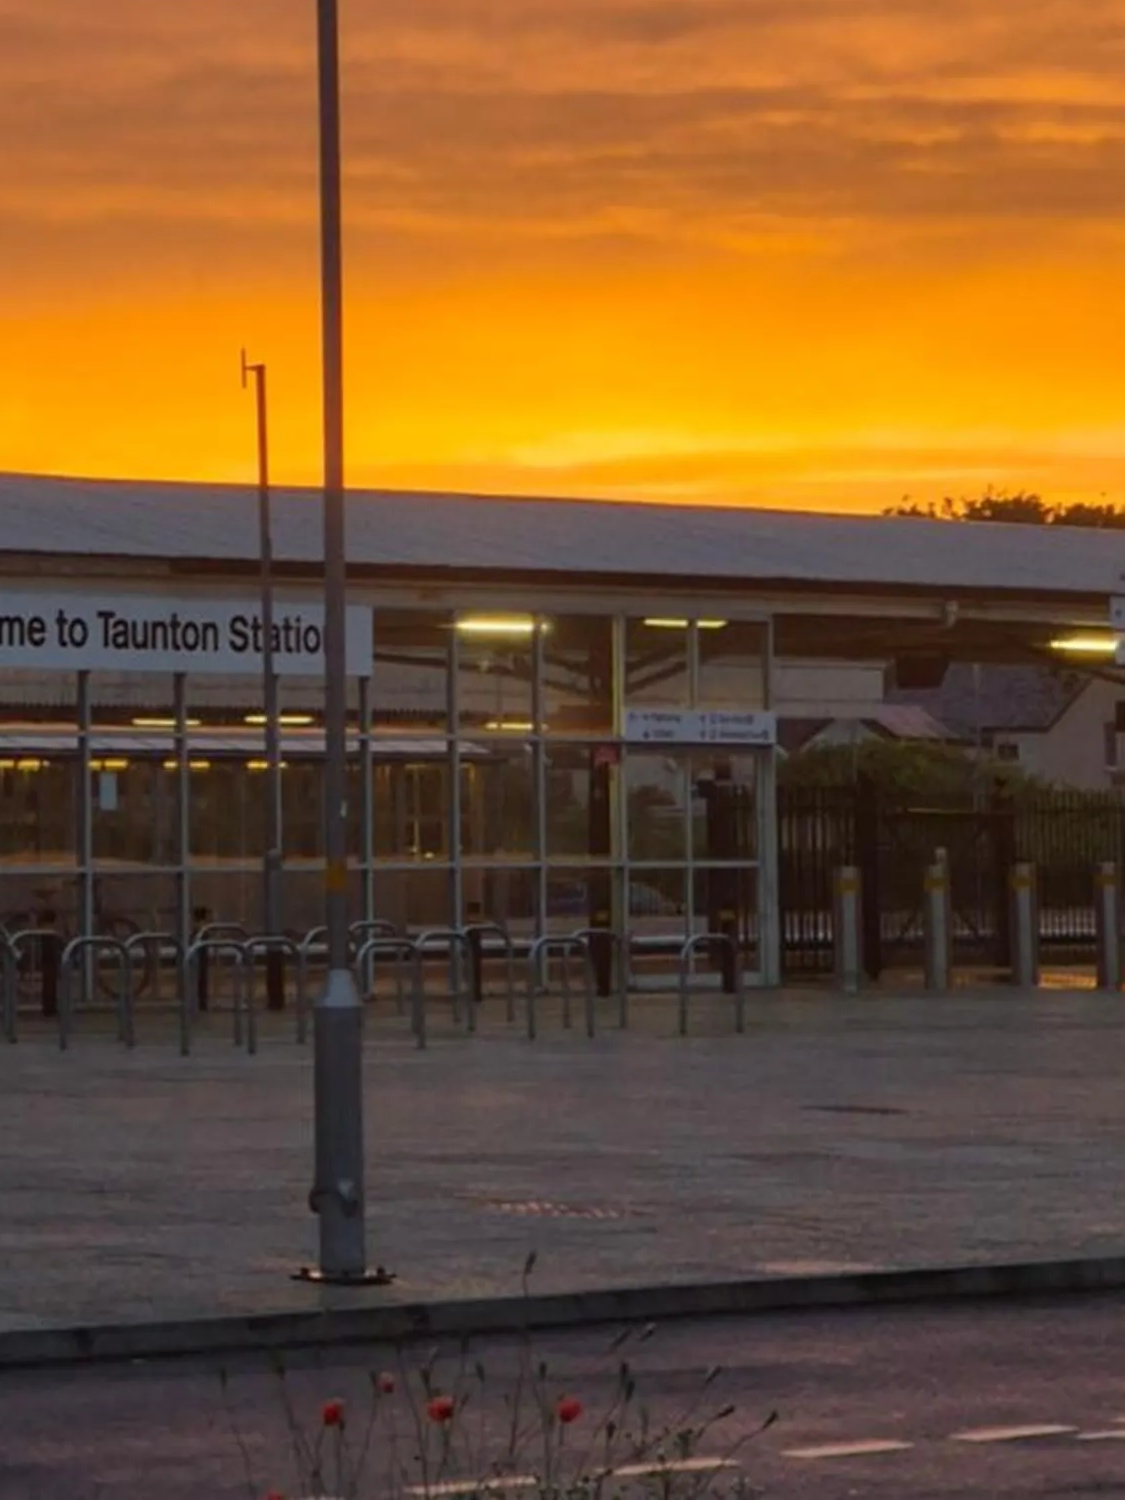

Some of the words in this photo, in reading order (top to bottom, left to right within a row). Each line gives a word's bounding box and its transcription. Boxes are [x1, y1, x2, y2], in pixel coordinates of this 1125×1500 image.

[56, 609, 89, 648] to
[97, 611, 219, 653] Taunton
[230, 615, 327, 655] Statio
